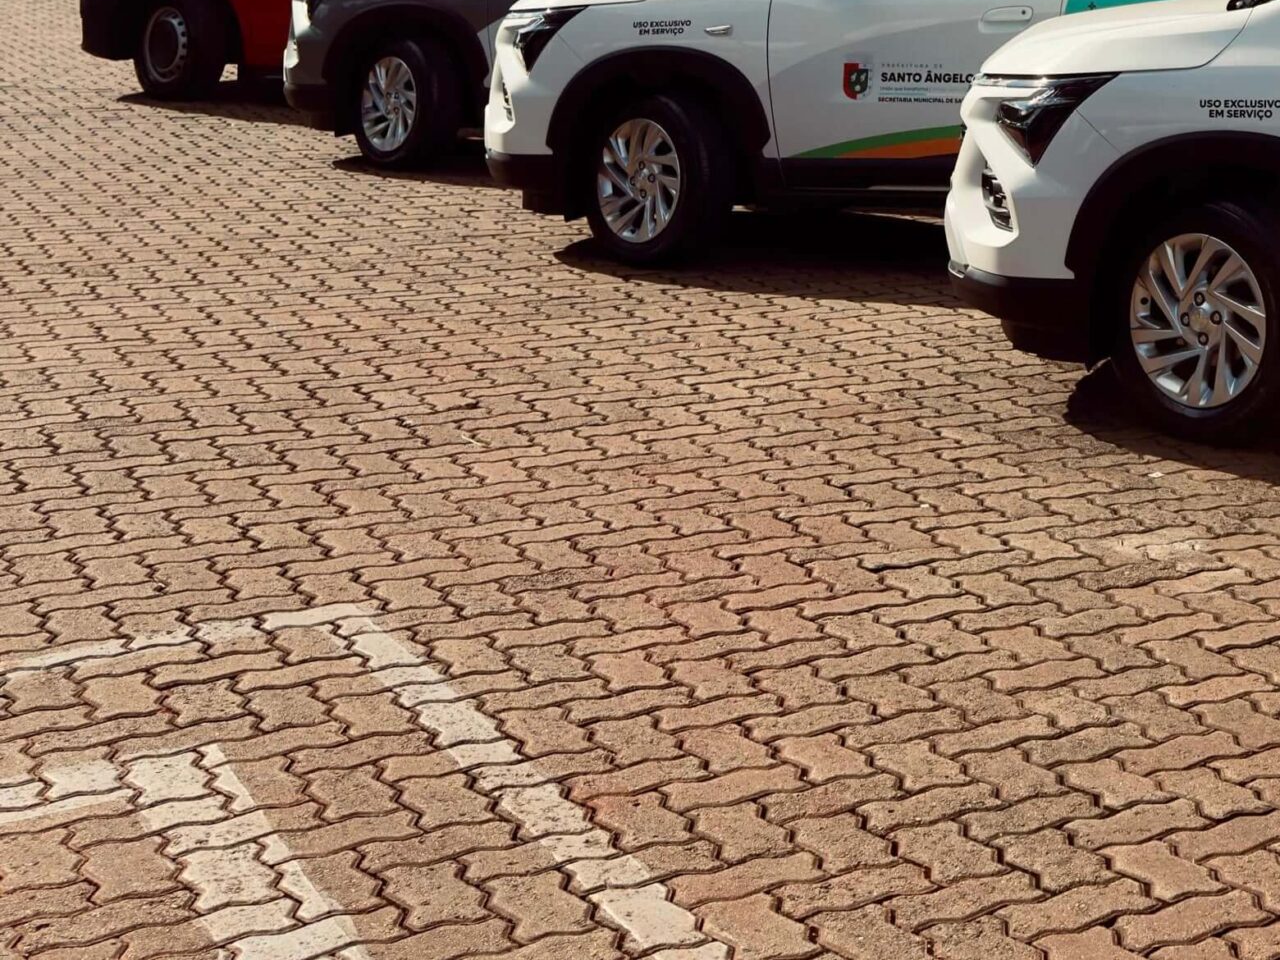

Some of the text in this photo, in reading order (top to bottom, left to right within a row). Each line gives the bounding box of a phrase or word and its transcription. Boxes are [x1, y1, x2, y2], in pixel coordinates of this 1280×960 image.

[651, 28, 684, 36] SERVIÇO
[881, 72, 922, 82] SANTO
[1200, 99, 1222, 108] USO
[1209, 109, 1273, 120] EM SERVIÇO
